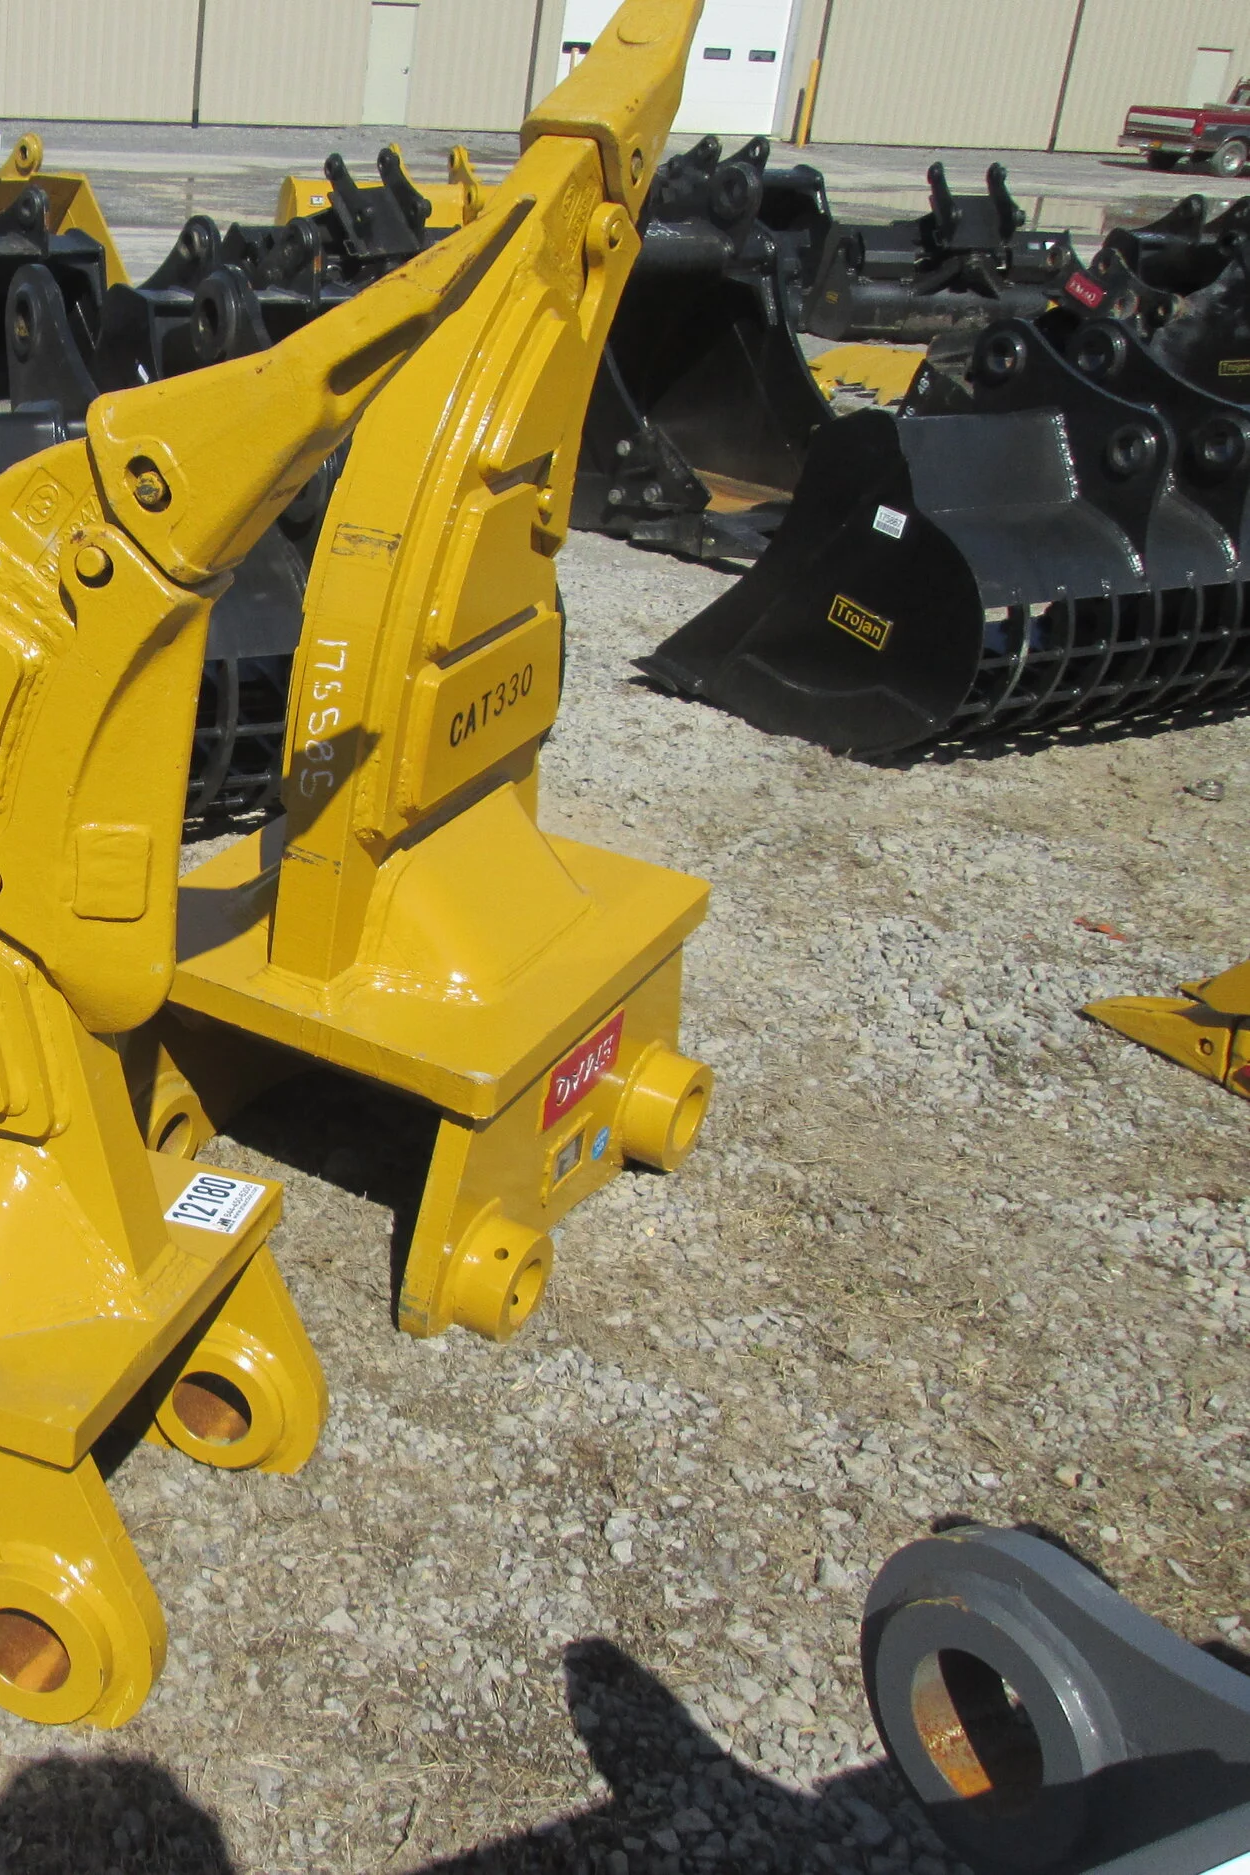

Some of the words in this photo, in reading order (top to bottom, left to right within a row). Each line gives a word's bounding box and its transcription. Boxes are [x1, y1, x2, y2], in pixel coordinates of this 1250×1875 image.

[837, 600, 882, 640] Trojan
[450, 663, 533, 748] CAT330
[555, 1032, 614, 1107] EMAQ
[171, 1176, 237, 1223] 12180
